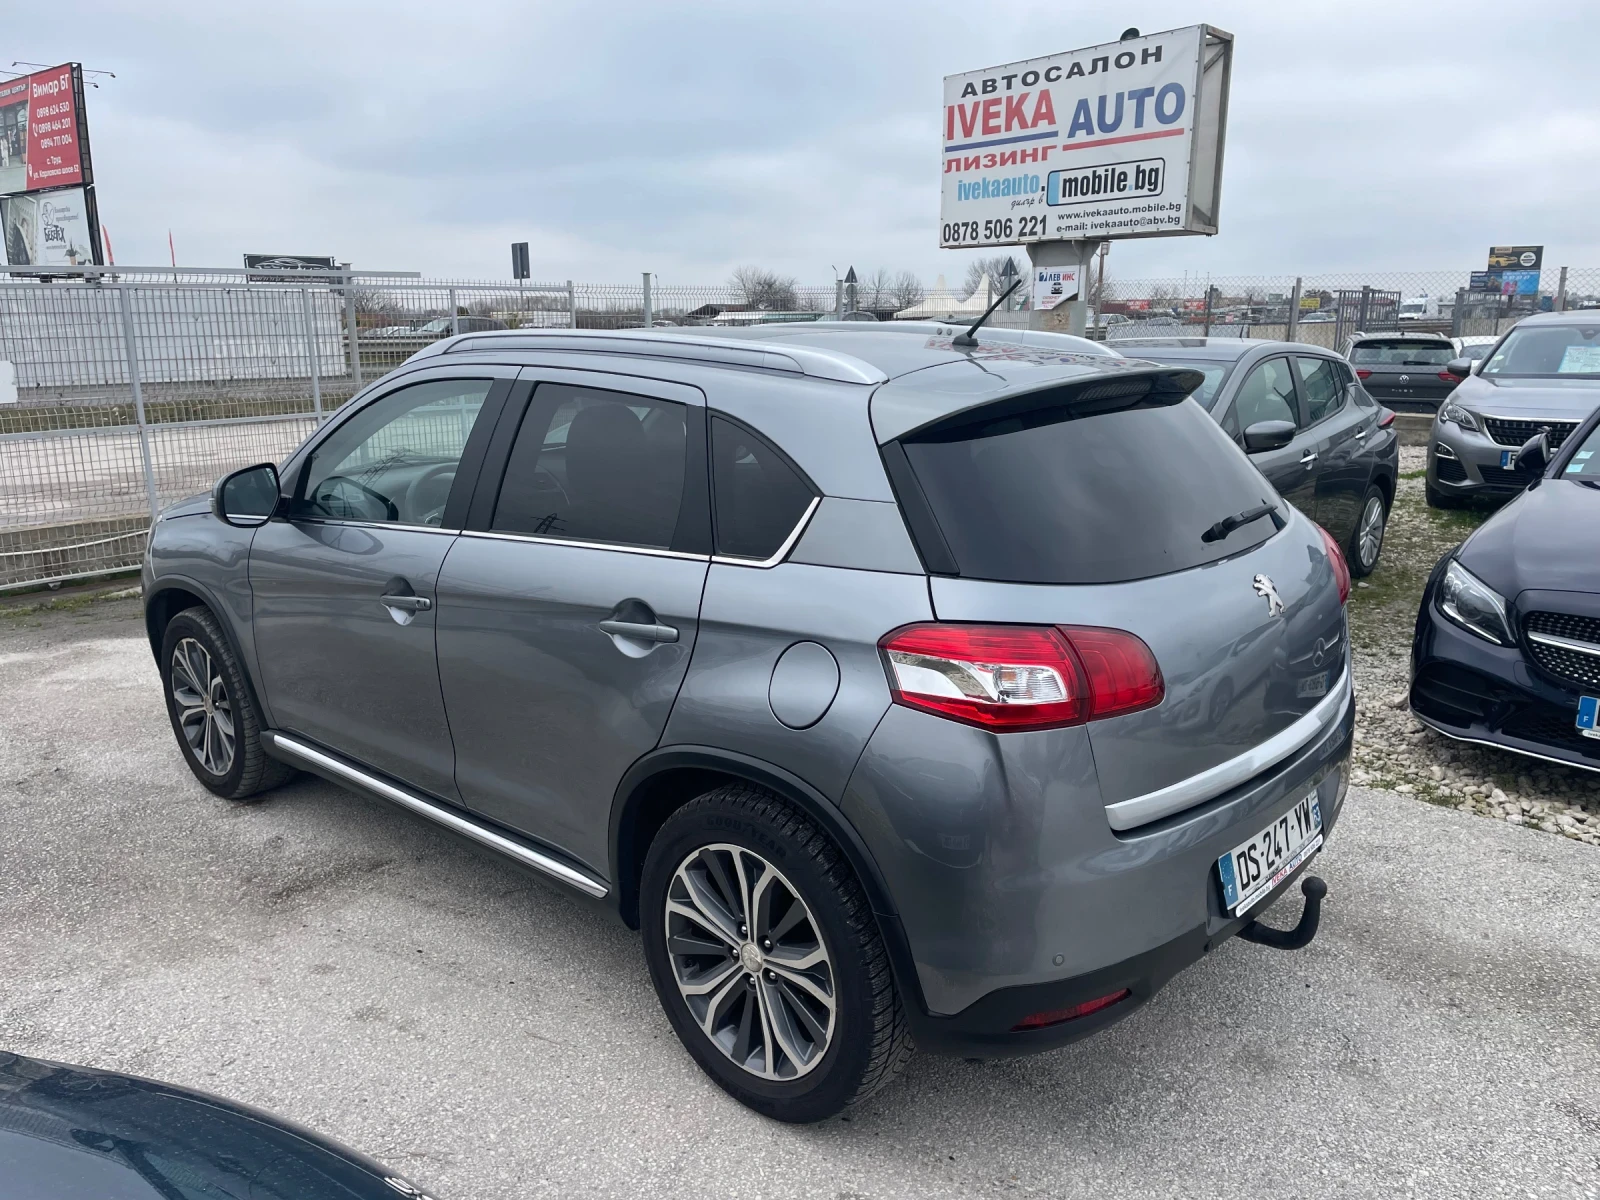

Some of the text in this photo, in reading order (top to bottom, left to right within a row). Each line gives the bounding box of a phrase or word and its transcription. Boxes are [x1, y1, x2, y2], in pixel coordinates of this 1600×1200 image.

[961, 45, 1163, 98] АВТОСАЛОН
[33, 74, 69, 98] Вимар БГ
[37, 102, 69, 118] 0898 624 530
[947, 82, 1186, 141] IVEKA AUTO
[39, 122, 51, 133] 0898
[944, 145, 1057, 173] ЛИЗИНГ
[1062, 164, 1160, 198] mobile.bg
[1056, 215, 1181, 232] e-mail: ivekaauto@abv.bg
[1058, 202, 1181, 220] www.ivekaauto.mobile.bg
[943, 214, 1047, 242] 0878 506 221
[1236, 797, 1311, 891] DS-247-YW
[1228, 884, 1233, 896] F
